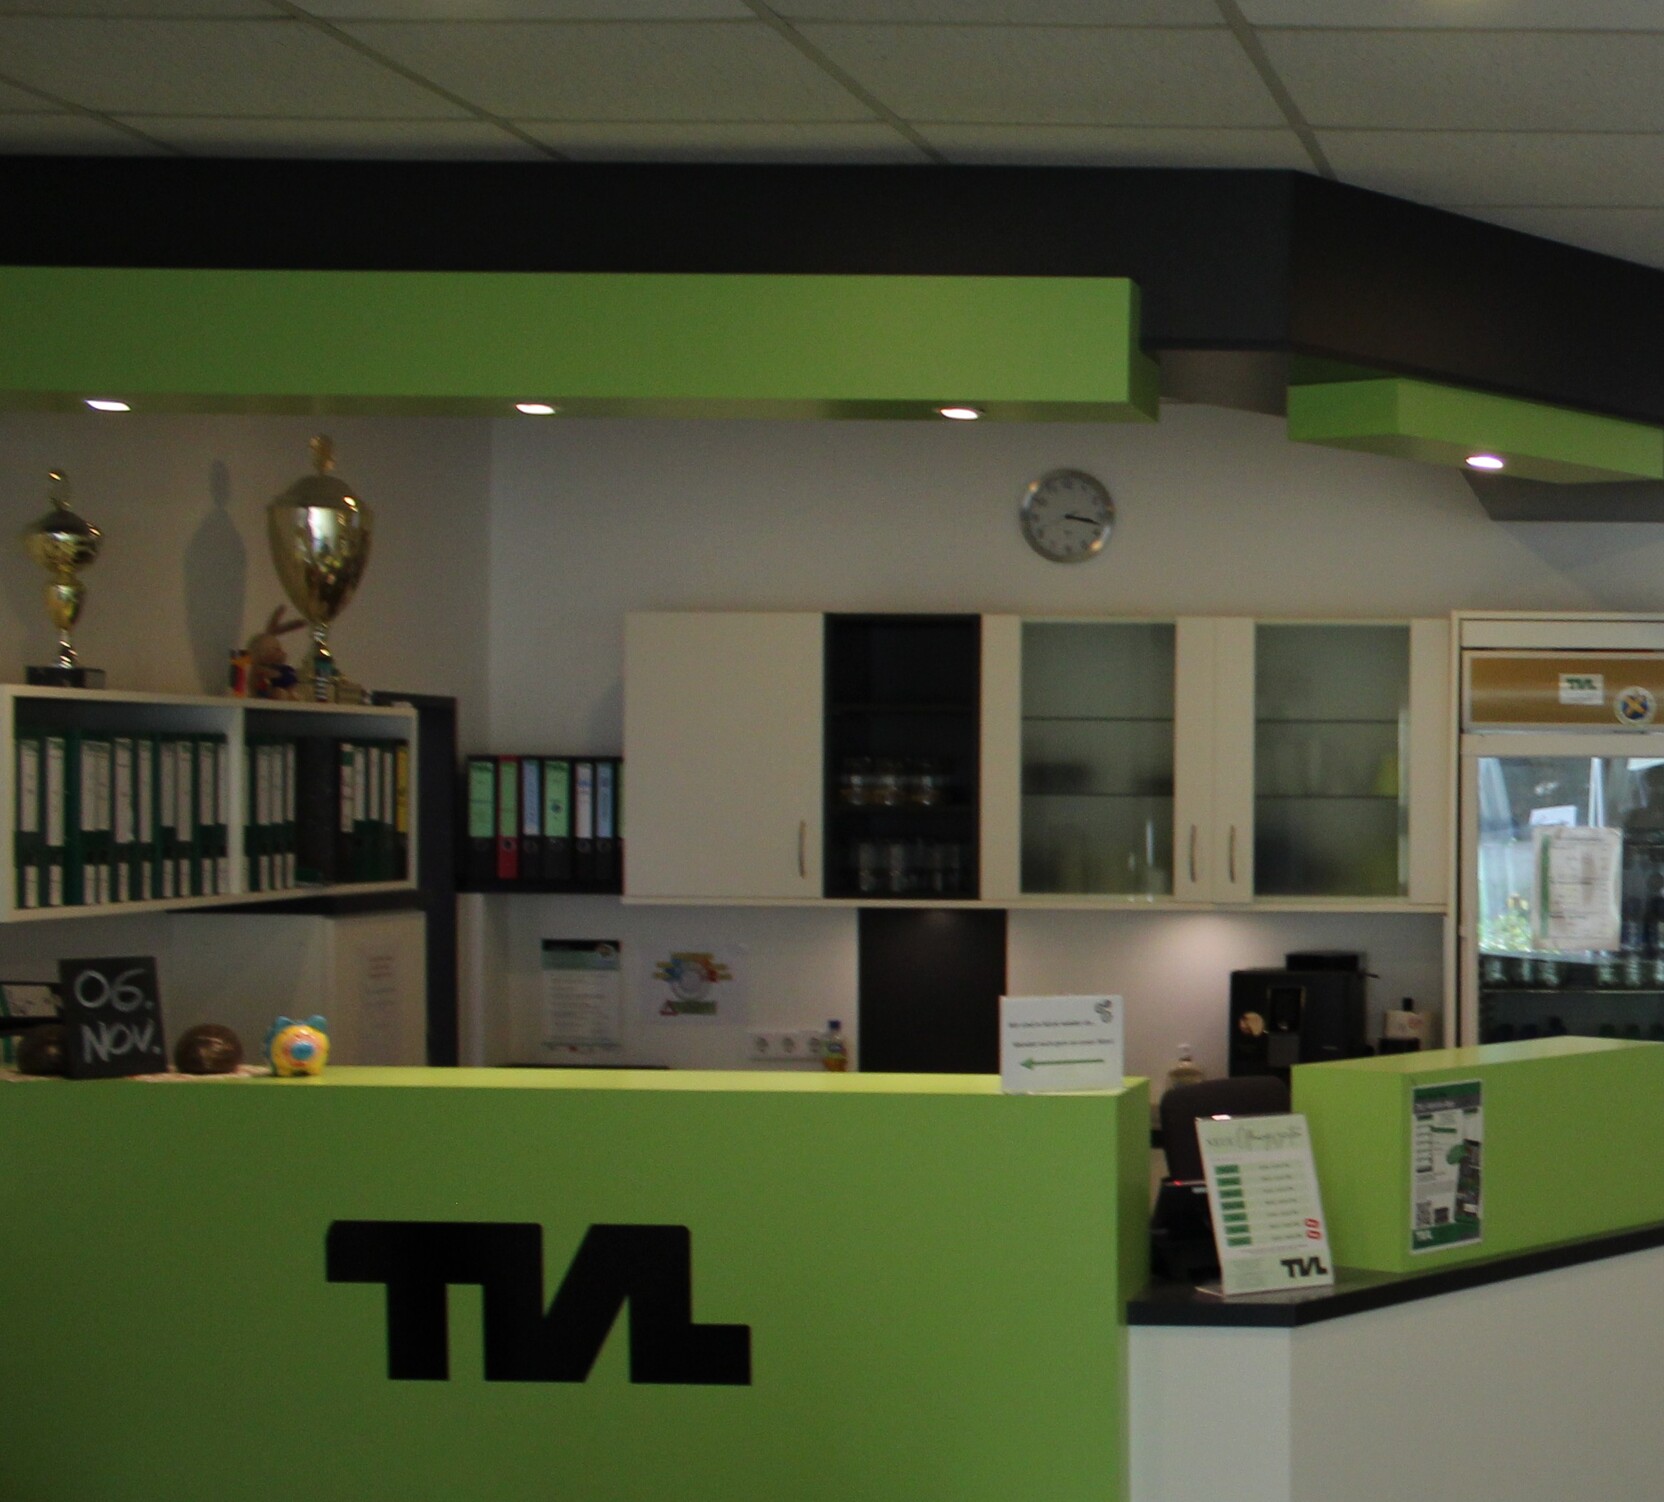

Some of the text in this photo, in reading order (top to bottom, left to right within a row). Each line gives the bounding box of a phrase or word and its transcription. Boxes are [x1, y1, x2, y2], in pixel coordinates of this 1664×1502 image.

[74, 969, 154, 1012] 06.
[1280, 1256, 1327, 1278] TVL
[326, 1220, 751, 1385] TVL
